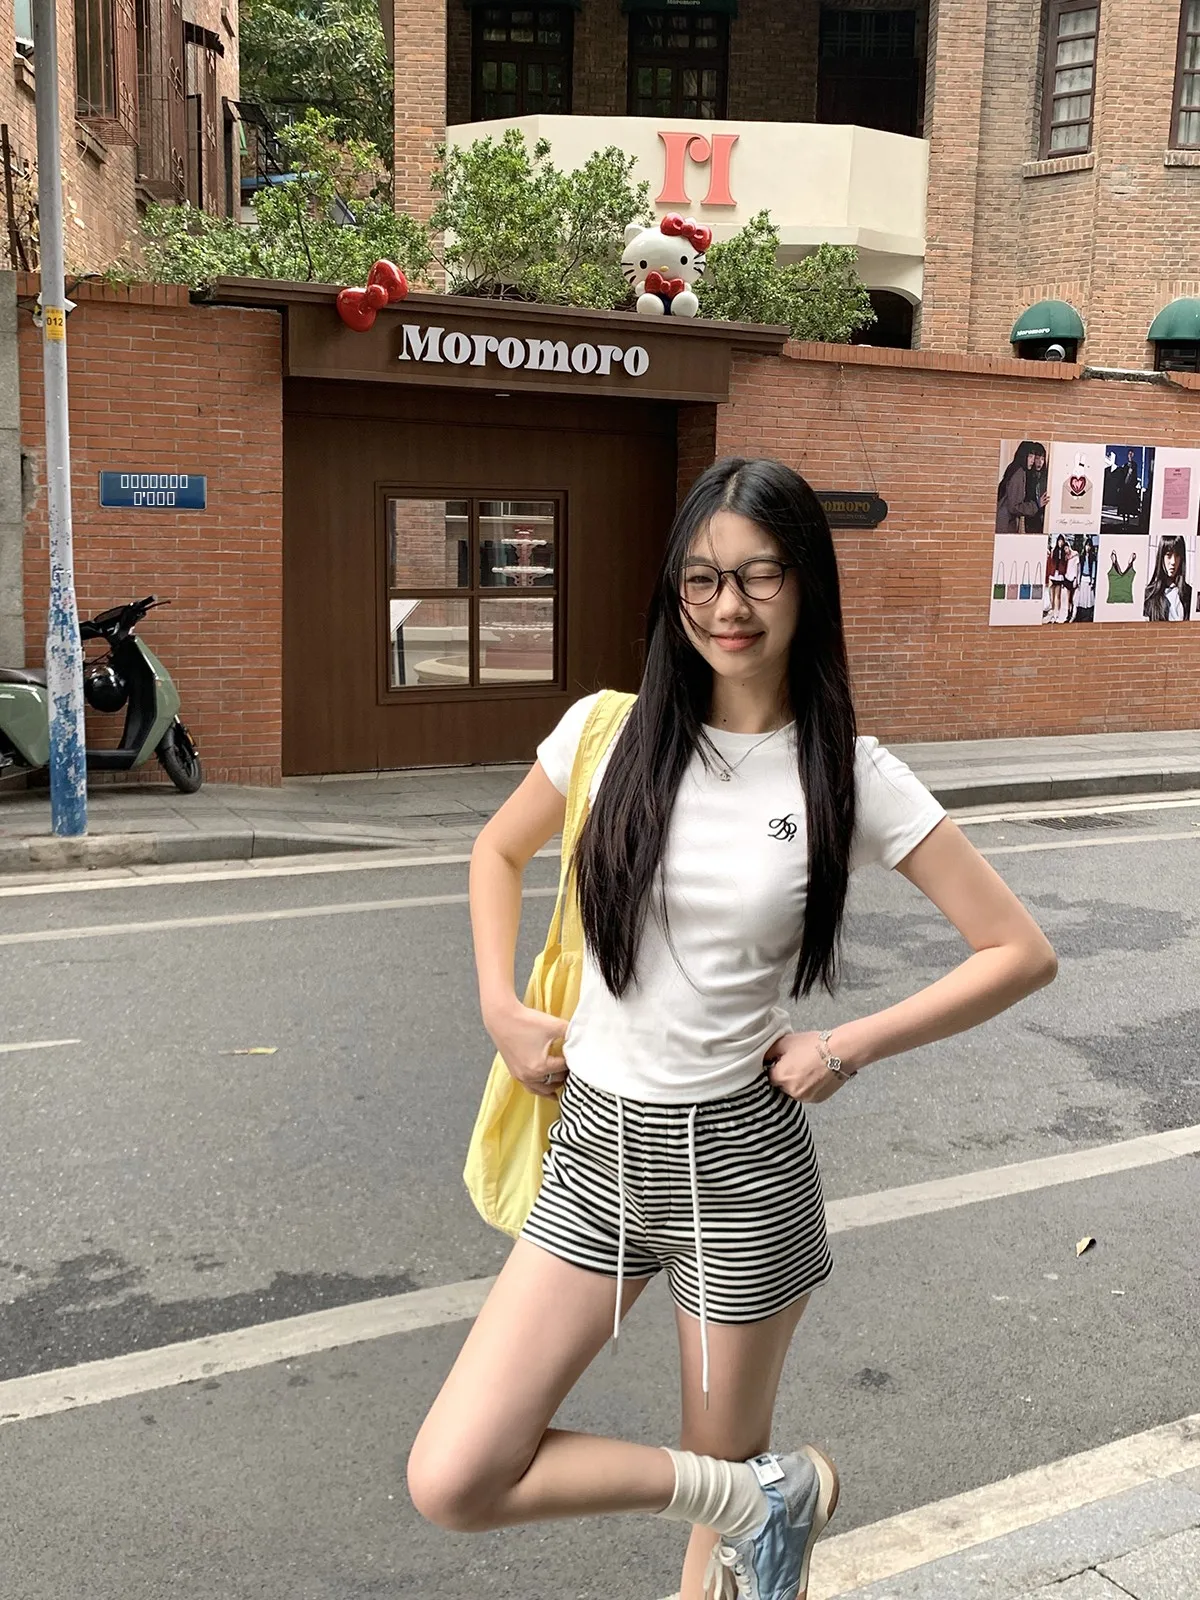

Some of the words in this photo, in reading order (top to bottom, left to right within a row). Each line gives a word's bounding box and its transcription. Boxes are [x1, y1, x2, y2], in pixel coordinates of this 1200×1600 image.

[46, 317, 63, 326] 012
[1016, 328, 1051, 337] Moromoro
[398, 324, 650, 377] Moromoro
